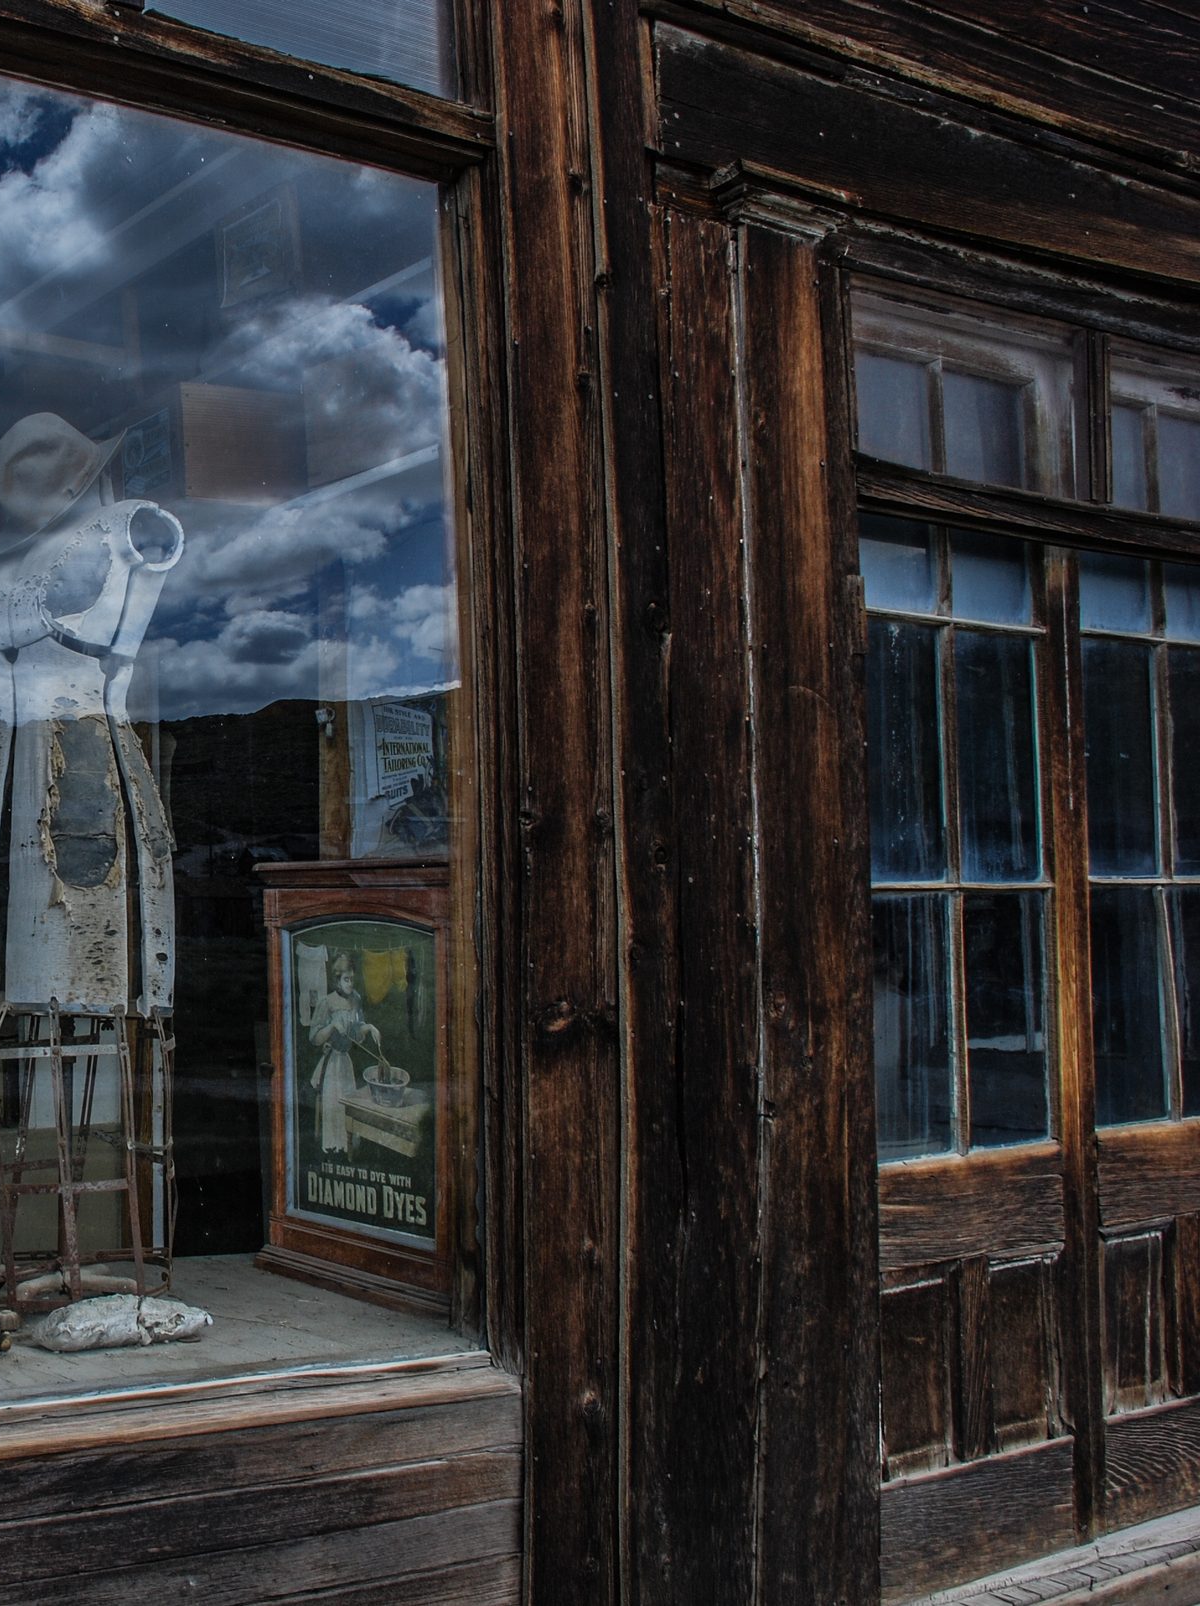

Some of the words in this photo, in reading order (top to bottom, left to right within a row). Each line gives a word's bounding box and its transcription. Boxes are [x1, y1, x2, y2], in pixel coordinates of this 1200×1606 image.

[382, 739, 429, 755] INTERNATIONAL
[382, 757, 416, 772] TAILORING
[336, 1165, 355, 1178] EASY
[357, 1168, 368, 1180] TO
[370, 1170, 386, 1184] DYE
[388, 1173, 412, 1189] WITH
[307, 1170, 377, 1216] DIAMOND
[382, 1184, 427, 1226] DYES
